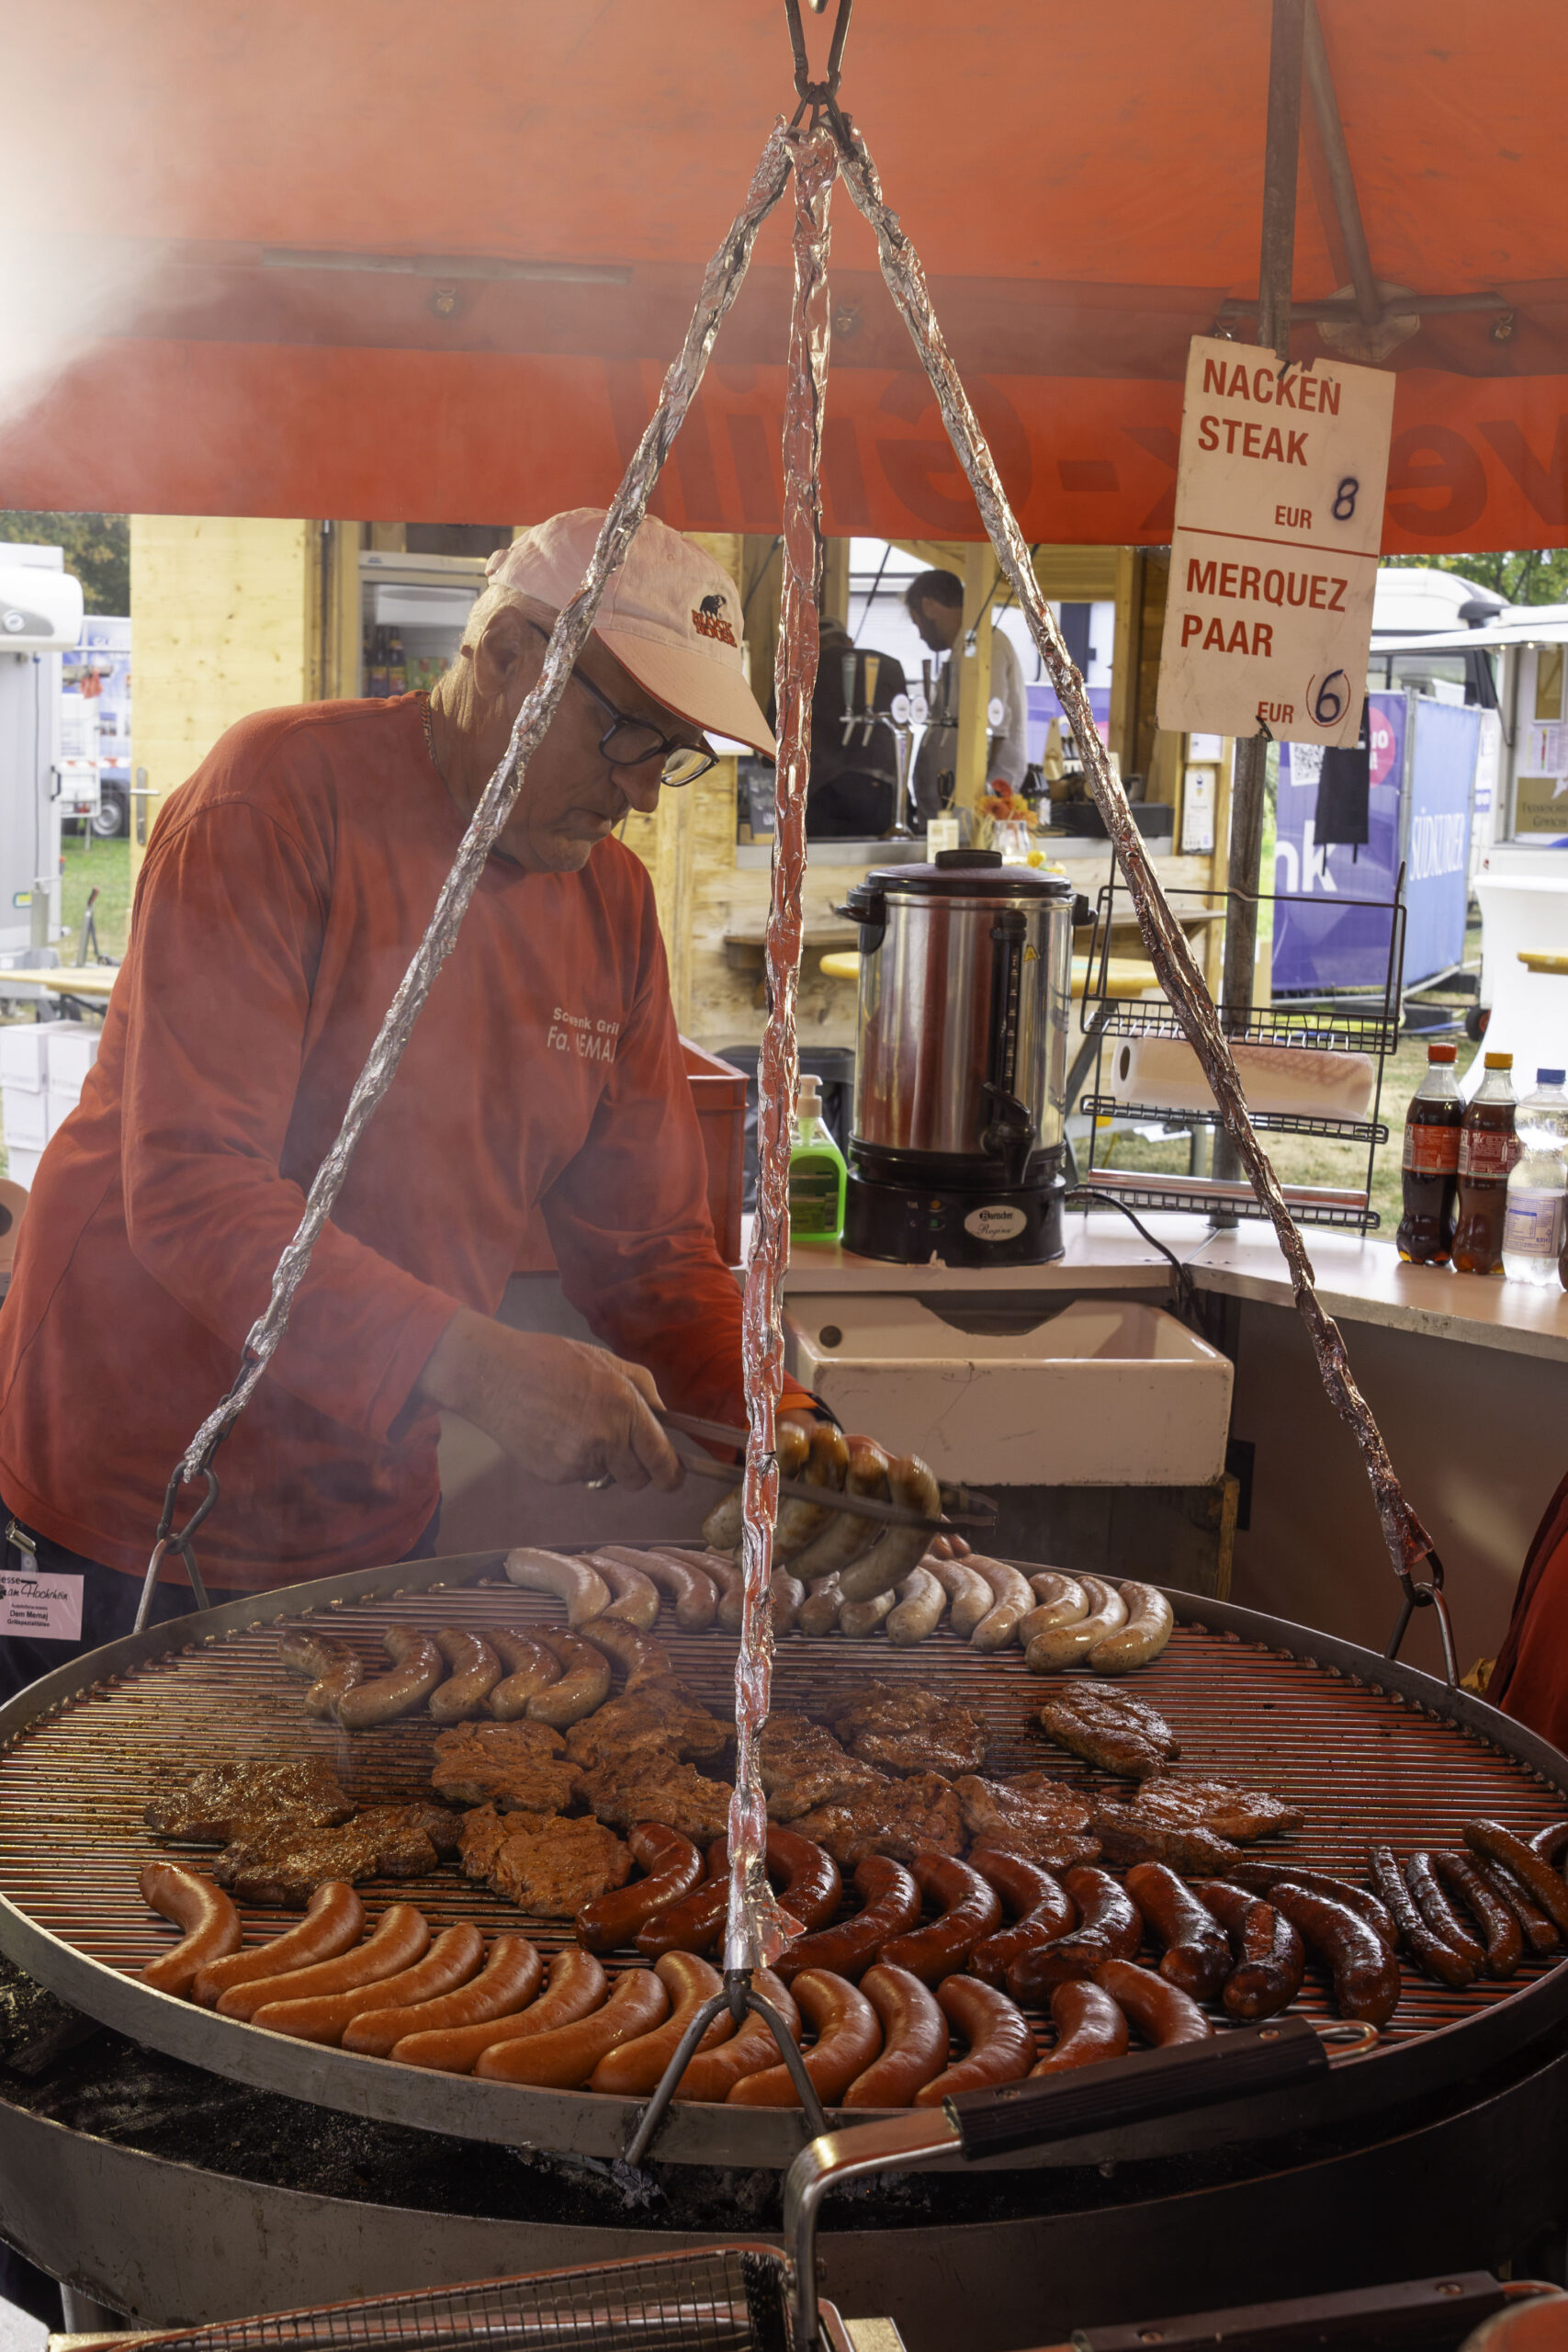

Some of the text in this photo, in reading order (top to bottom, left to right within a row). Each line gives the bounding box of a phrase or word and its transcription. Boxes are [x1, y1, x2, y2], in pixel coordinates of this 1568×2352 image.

[1202, 358, 1341, 416] NACKEN
[1197, 415, 1310, 467] STEAK
[1274, 477, 1359, 529] EUR 8
[1186, 558, 1348, 613] MERQUEZ
[1180, 614, 1274, 657] PAAR
[1257, 669, 1345, 724] EUR 6
[0, 1576, 22, 1585] esse
[7, 1583, 68, 1600] am Hochrhein
